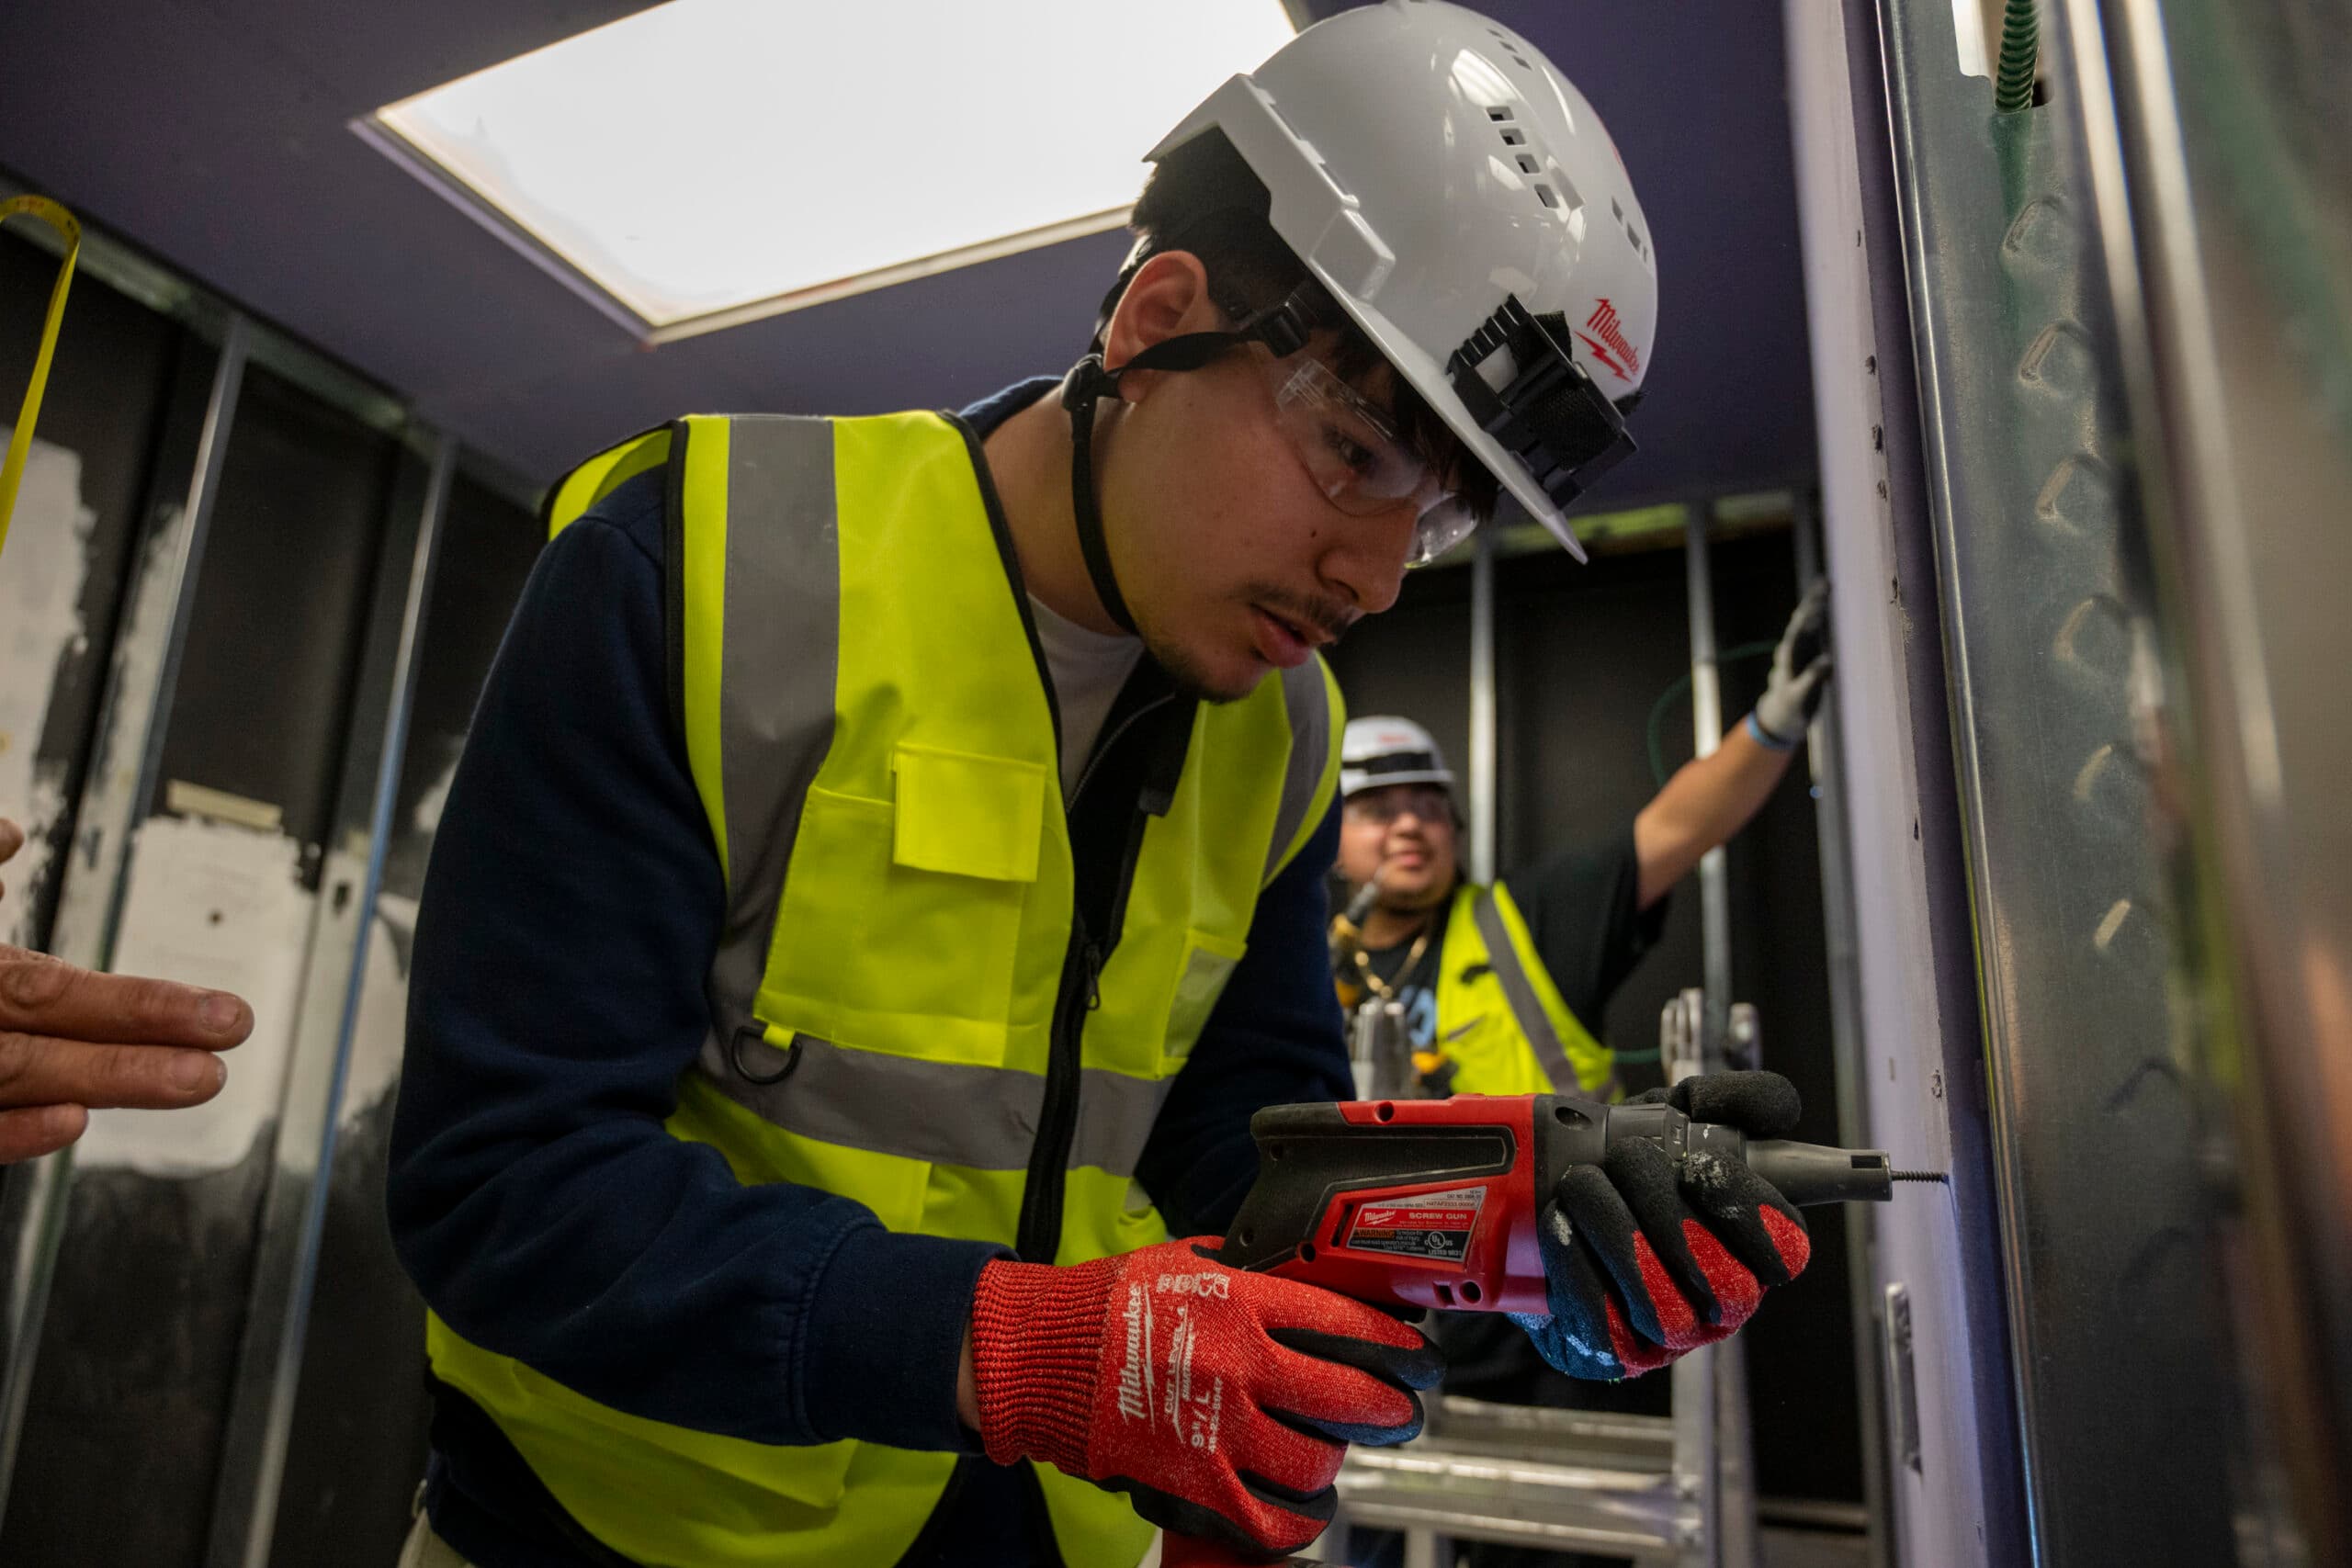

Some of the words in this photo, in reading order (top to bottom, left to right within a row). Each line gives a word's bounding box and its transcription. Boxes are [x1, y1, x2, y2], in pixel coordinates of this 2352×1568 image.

[1359, 1229, 1396, 1238] WARNING
[1408, 1212, 1443, 1220] SCREW
[1446, 1212, 1467, 1220] GUN
[1118, 1281, 1148, 1425] Milwaukee
[1168, 1322, 1185, 1376] LEVEL
[1164, 1380, 1176, 1415] CUT
